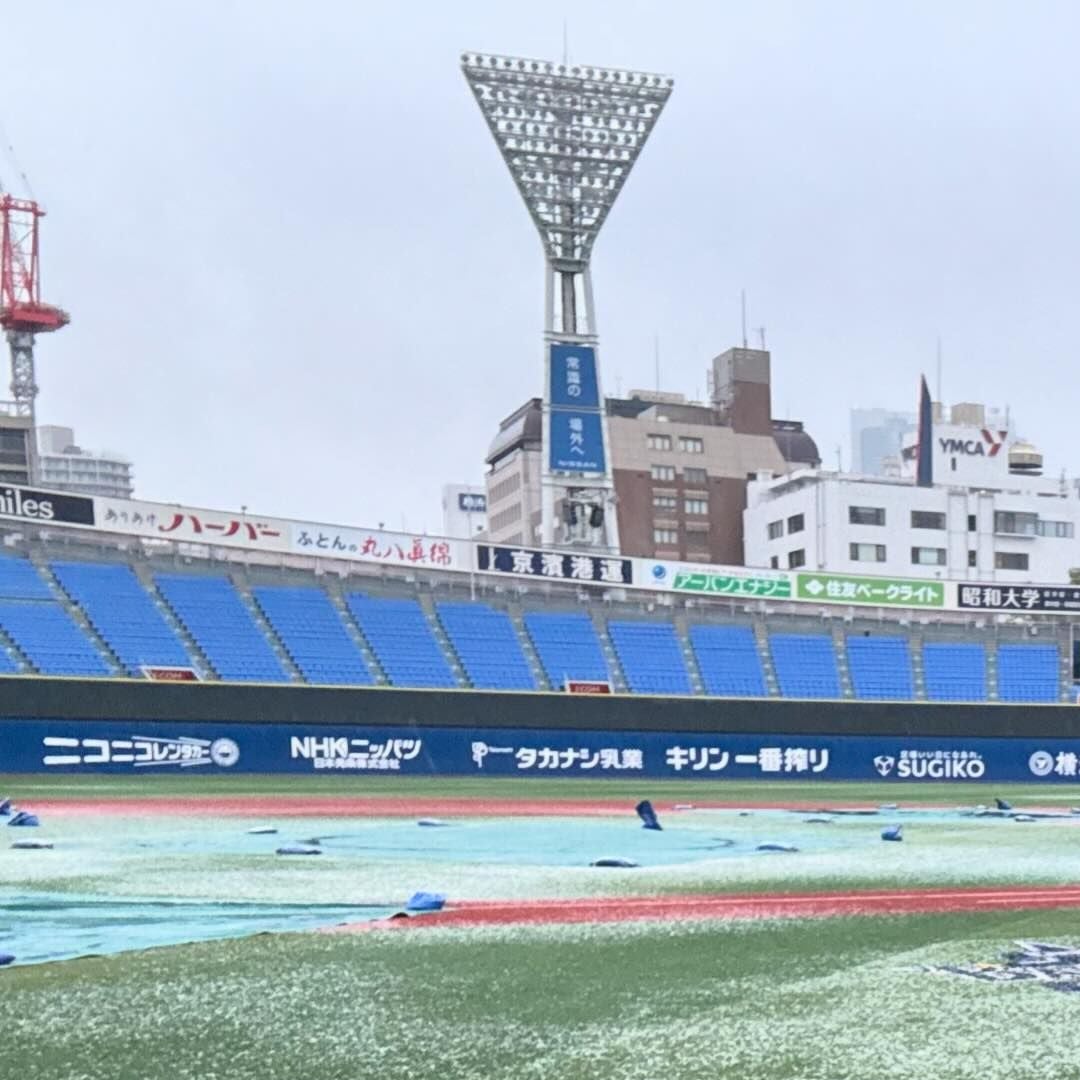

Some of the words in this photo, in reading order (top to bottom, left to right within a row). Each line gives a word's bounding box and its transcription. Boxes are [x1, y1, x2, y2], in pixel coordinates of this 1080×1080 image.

[939, 437, 985, 457] YMCA
[158, 513, 280, 541] ハーバー
[677, 573, 790, 597] アーバンエナジー
[826, 579, 938, 603] 住友ベークライト
[961, 586, 1041, 608] 昭和大学
[43, 736, 211, 766] ニコニコレンタカー
[515, 748, 643, 769] タカナシ乳業
[898, 759, 985, 778] SUGIKO
